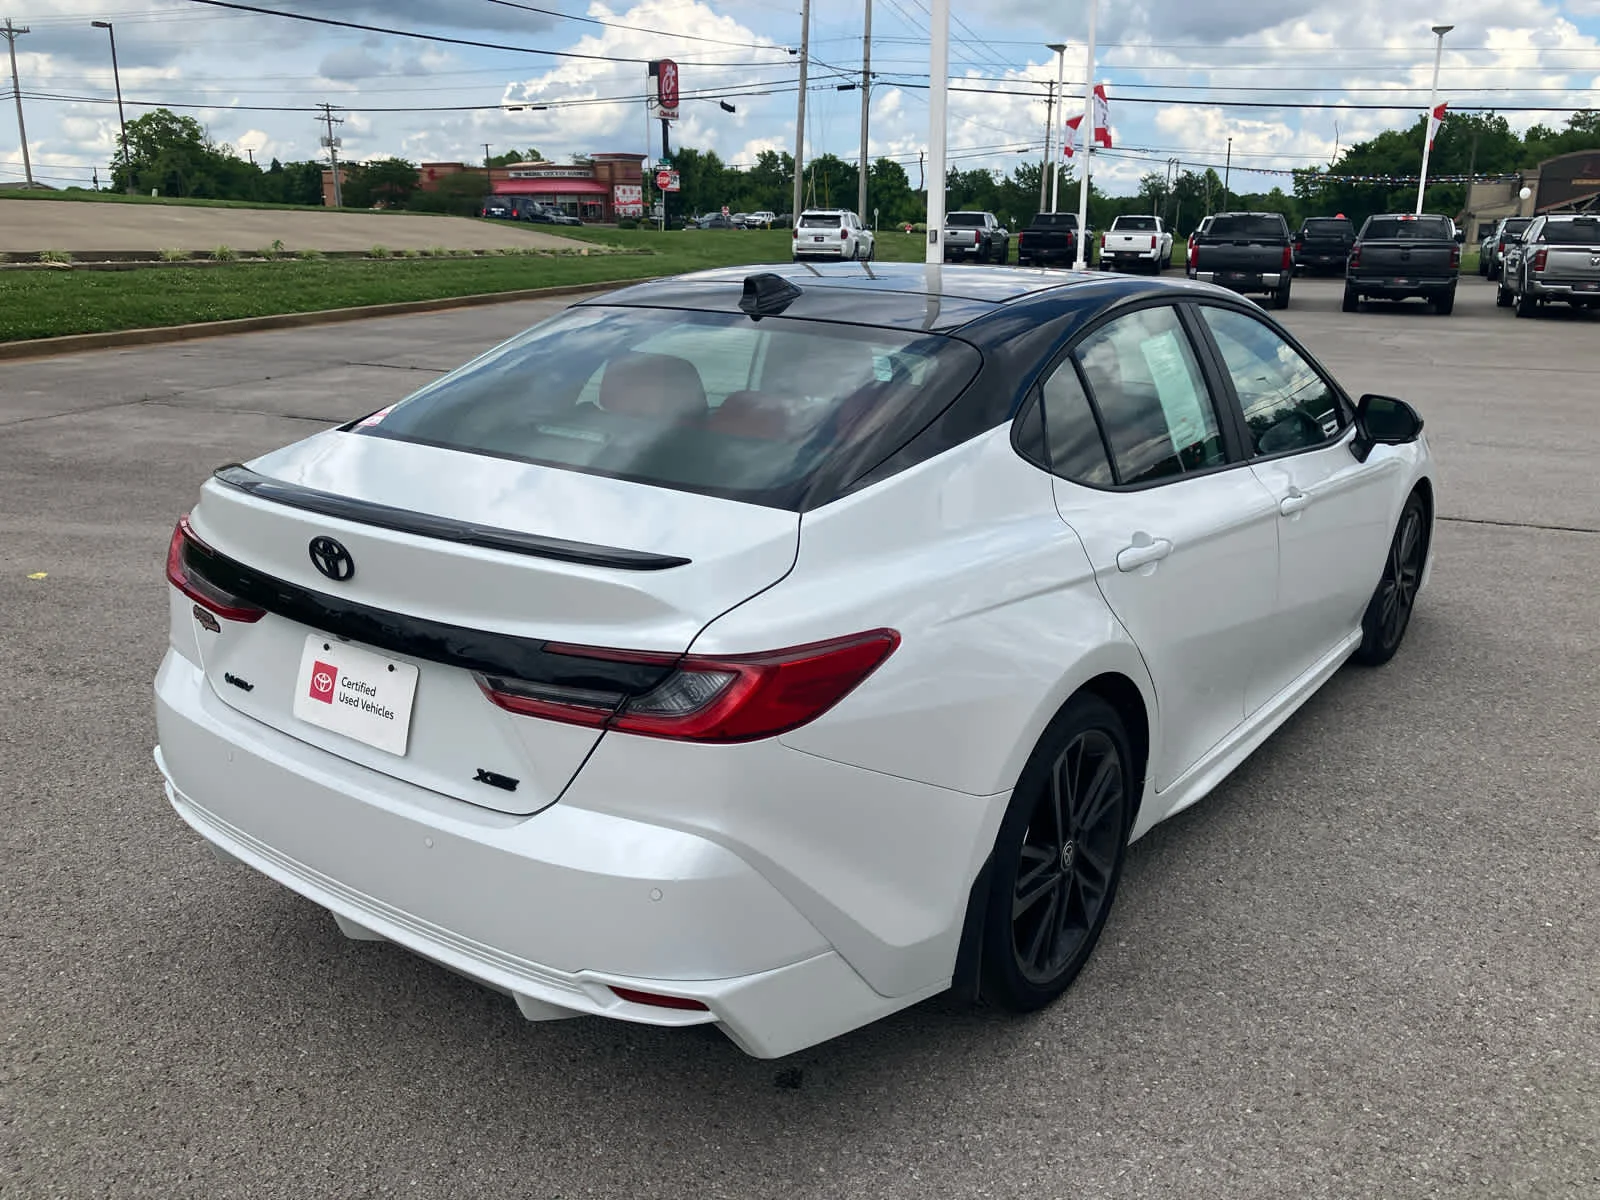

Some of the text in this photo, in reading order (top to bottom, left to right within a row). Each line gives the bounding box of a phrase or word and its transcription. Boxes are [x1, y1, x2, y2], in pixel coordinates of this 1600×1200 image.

[341, 676, 377, 697] Certified
[338, 691, 395, 720] Used Vehicles
